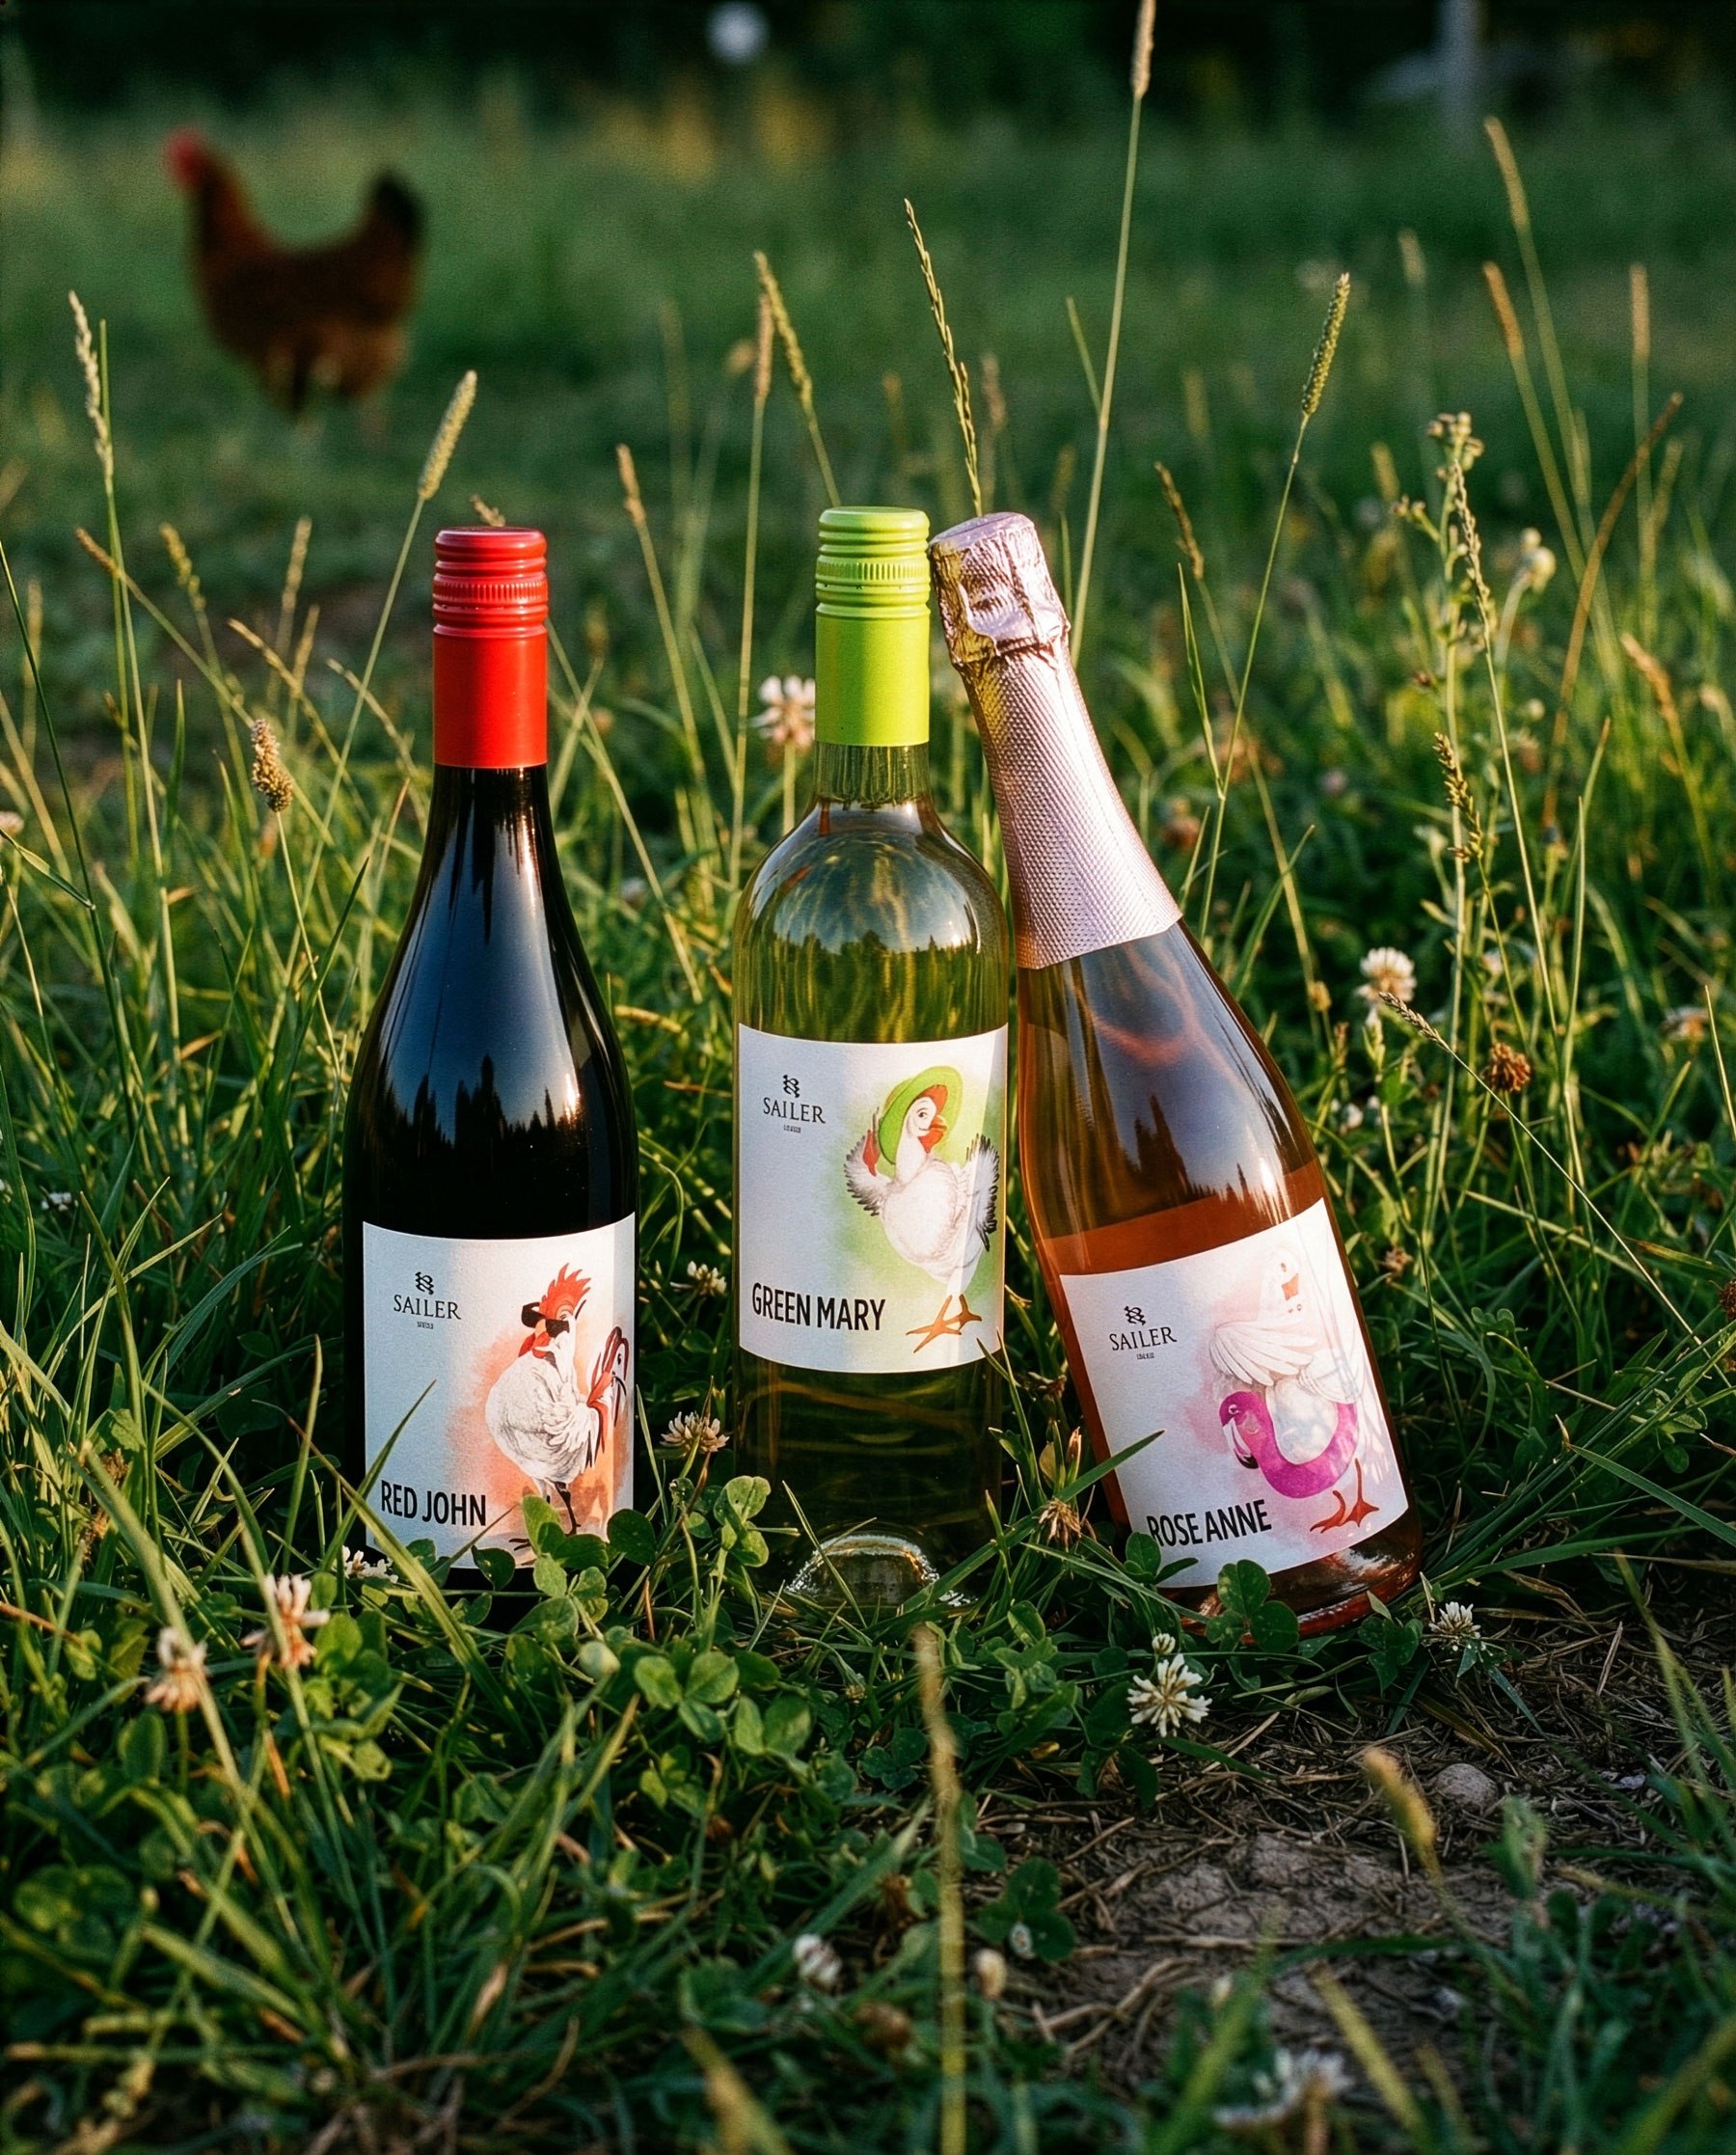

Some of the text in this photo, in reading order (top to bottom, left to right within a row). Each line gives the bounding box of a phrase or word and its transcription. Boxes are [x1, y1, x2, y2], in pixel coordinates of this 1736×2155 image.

[763, 1097, 827, 1124] SAILER
[393, 1294, 462, 1321] SAILER
[751, 1282, 886, 1331] GREEN MARY
[1109, 1325, 1178, 1351] SAILER
[380, 1479, 486, 1527] RED JOHN
